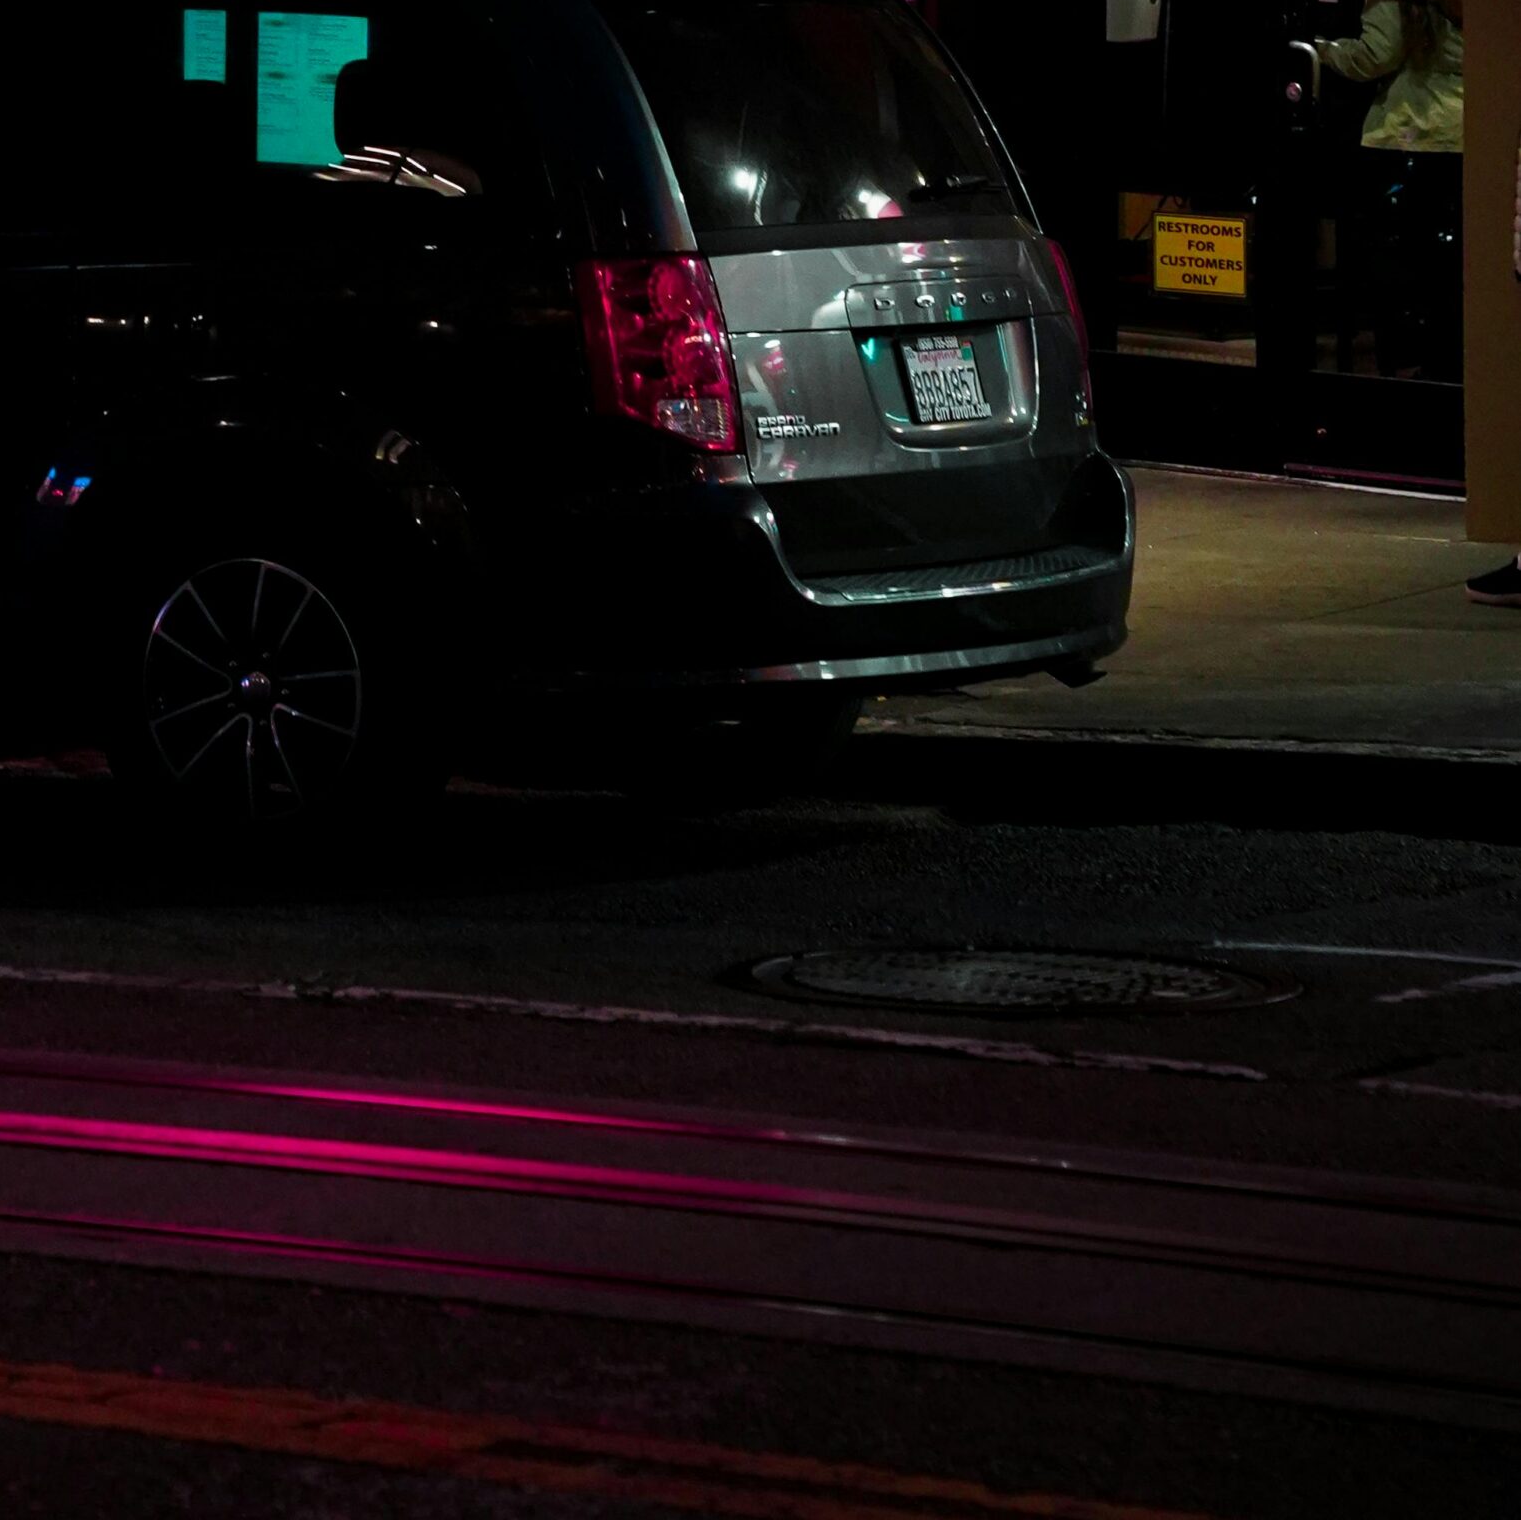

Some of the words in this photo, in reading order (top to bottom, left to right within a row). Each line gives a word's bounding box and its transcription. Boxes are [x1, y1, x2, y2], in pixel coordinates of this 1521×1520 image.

[1159, 221, 1243, 238] RESTROOMS
[1187, 239, 1216, 253] FOR
[1160, 254, 1244, 271] CUSTOMERS
[1181, 273, 1219, 286] ONLY
[757, 422, 841, 439] CARAVAN
